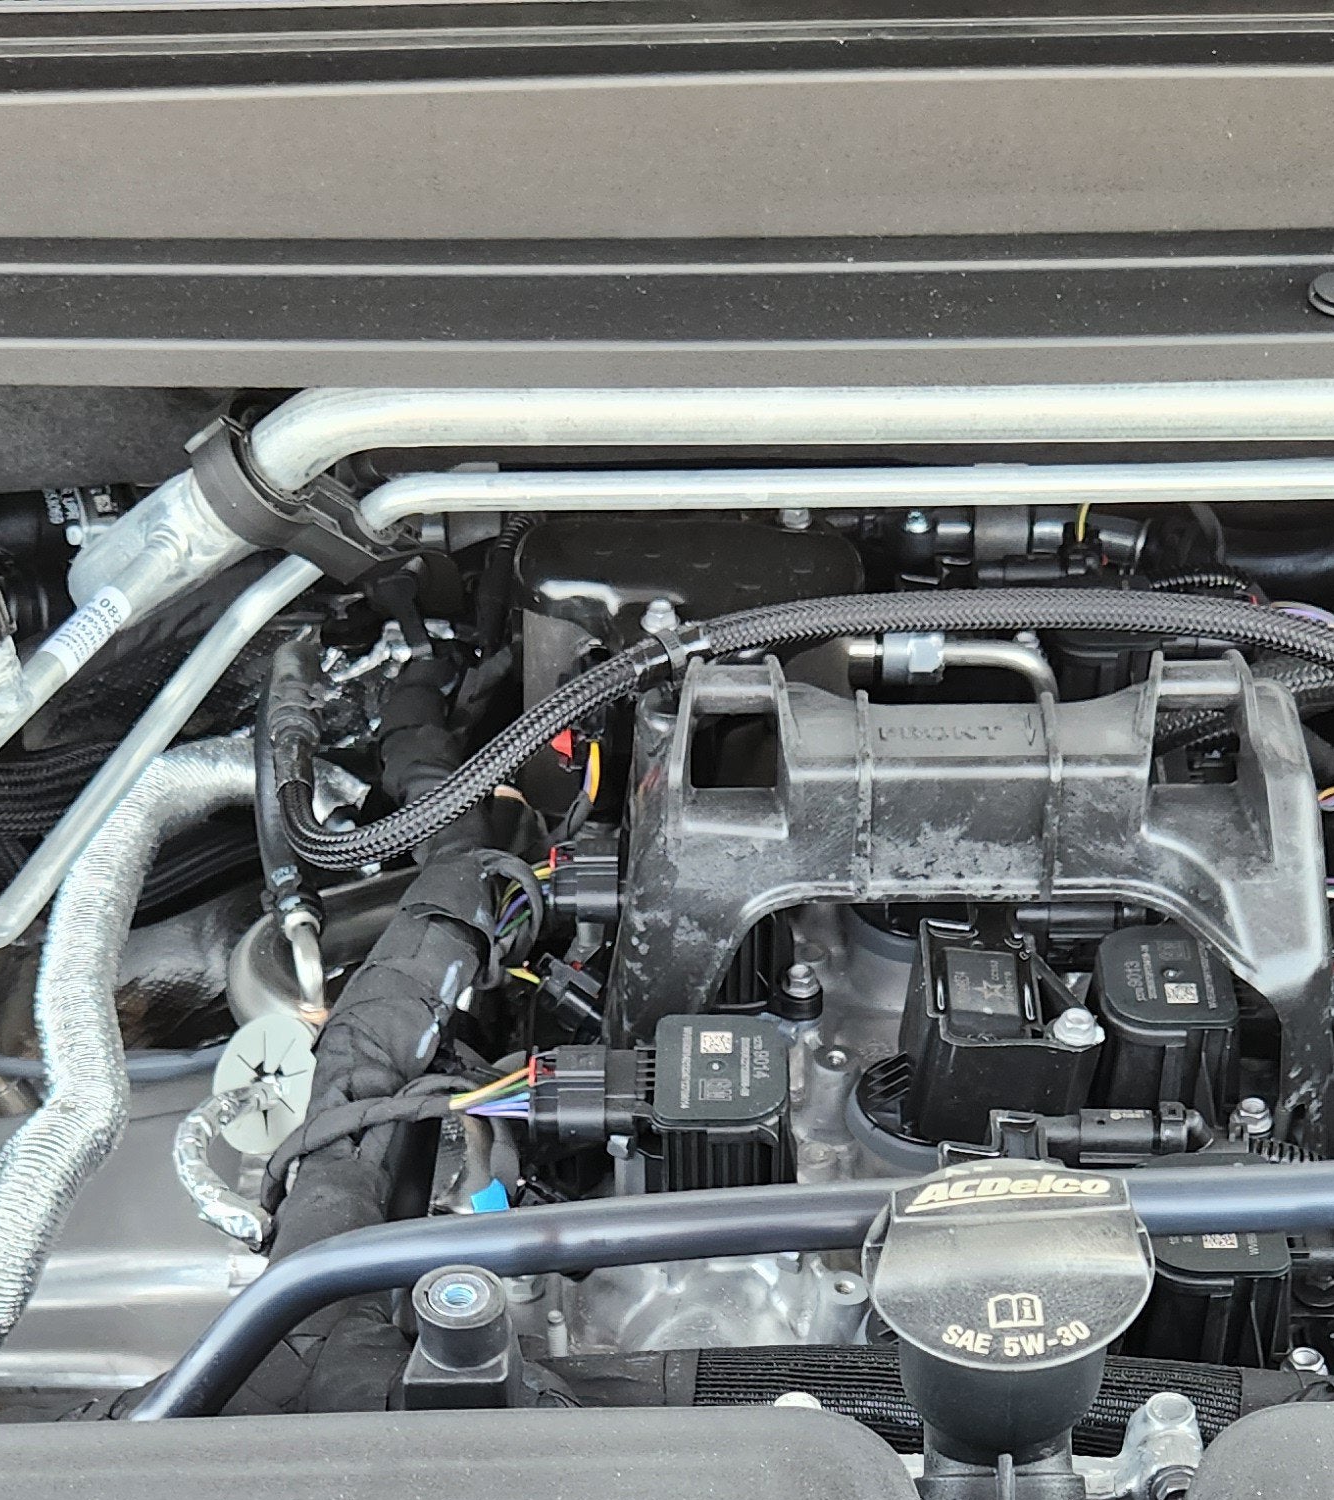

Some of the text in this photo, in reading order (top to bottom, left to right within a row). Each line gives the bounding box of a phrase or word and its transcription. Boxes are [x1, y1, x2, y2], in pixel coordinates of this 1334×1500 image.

[909, 1174, 1112, 1210] ACDelco
[942, 1320, 1091, 1357] SAE 5W-30
